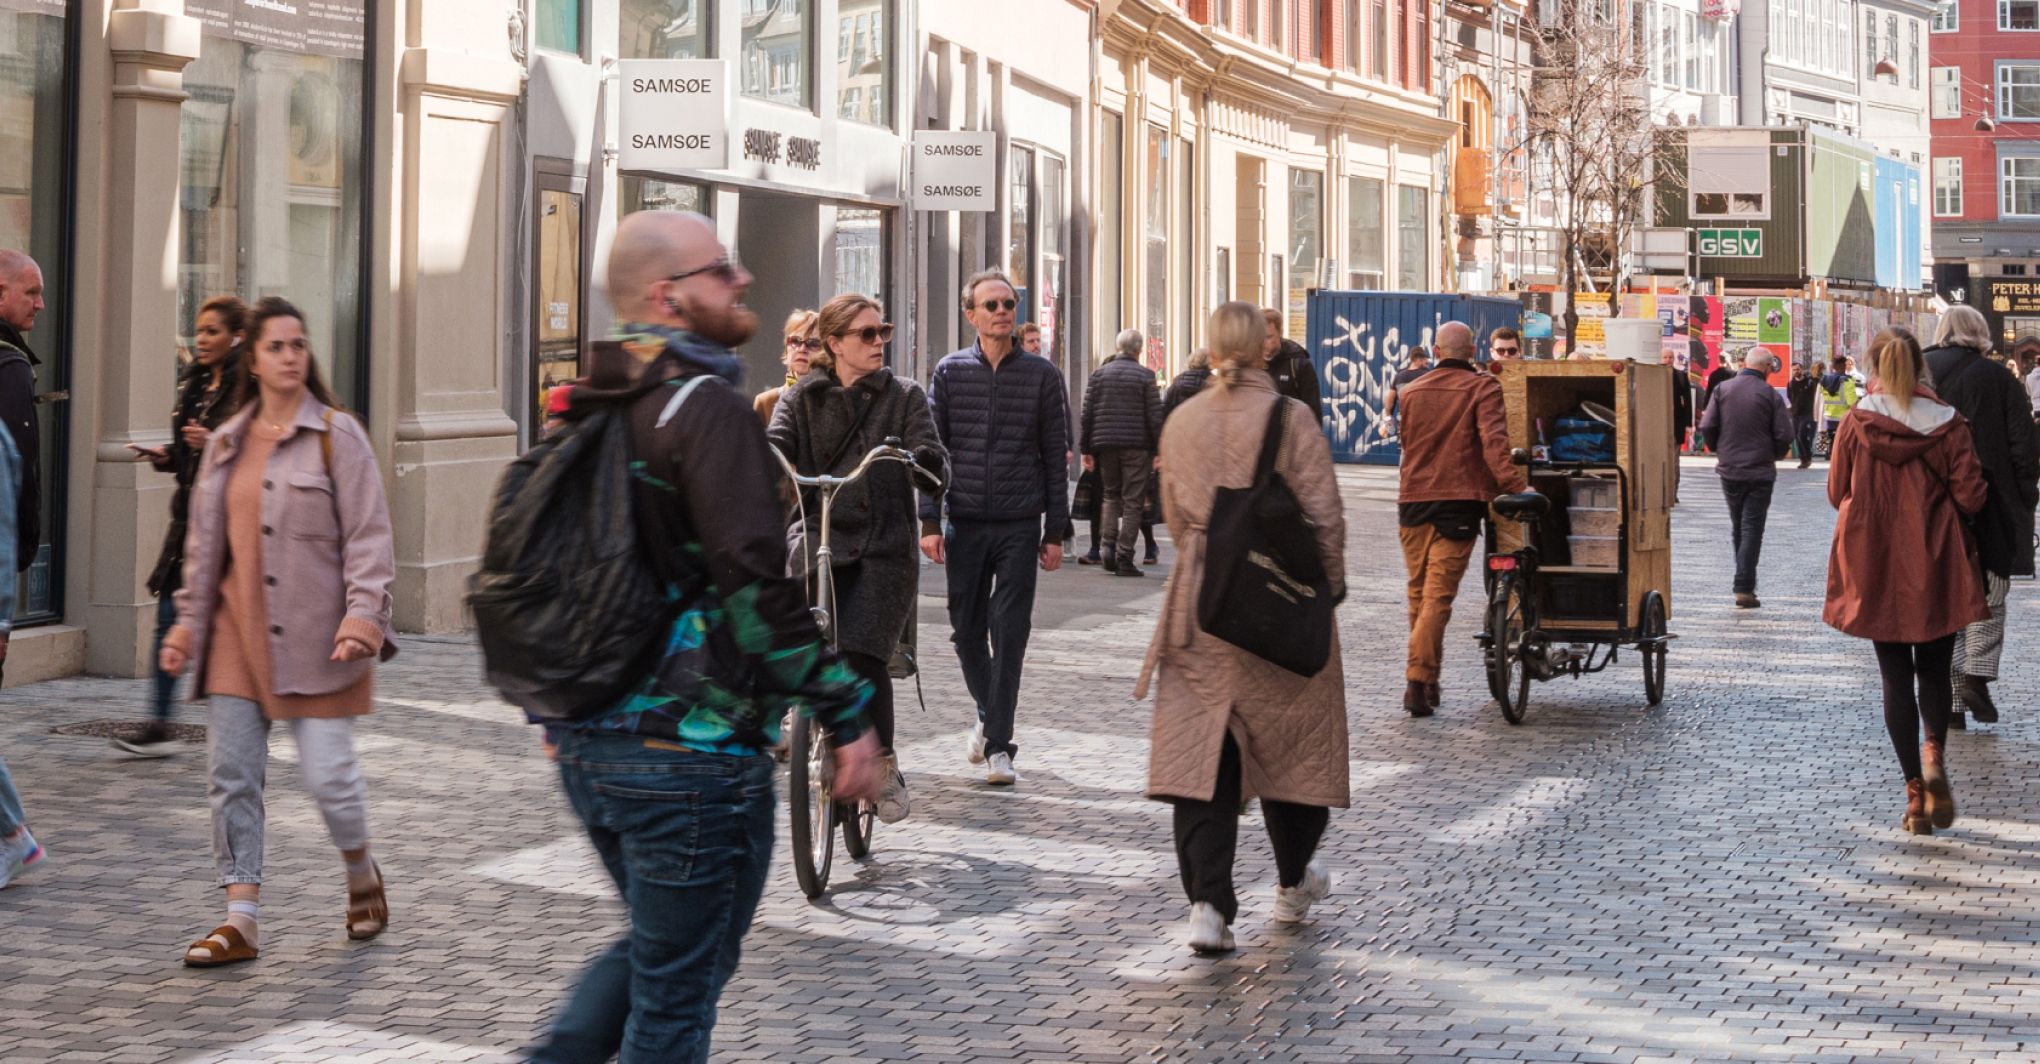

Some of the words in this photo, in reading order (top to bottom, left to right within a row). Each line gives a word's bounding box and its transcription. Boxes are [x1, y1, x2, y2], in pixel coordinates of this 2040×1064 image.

[632, 78, 712, 94] SAMSØE
[631, 134, 711, 150] SAMSØE
[924, 144, 983, 156] SAMSØE
[923, 185, 982, 197] SAMSØE
[1700, 238, 1759, 255] GSV
[1992, 283, 2031, 295] PETER
